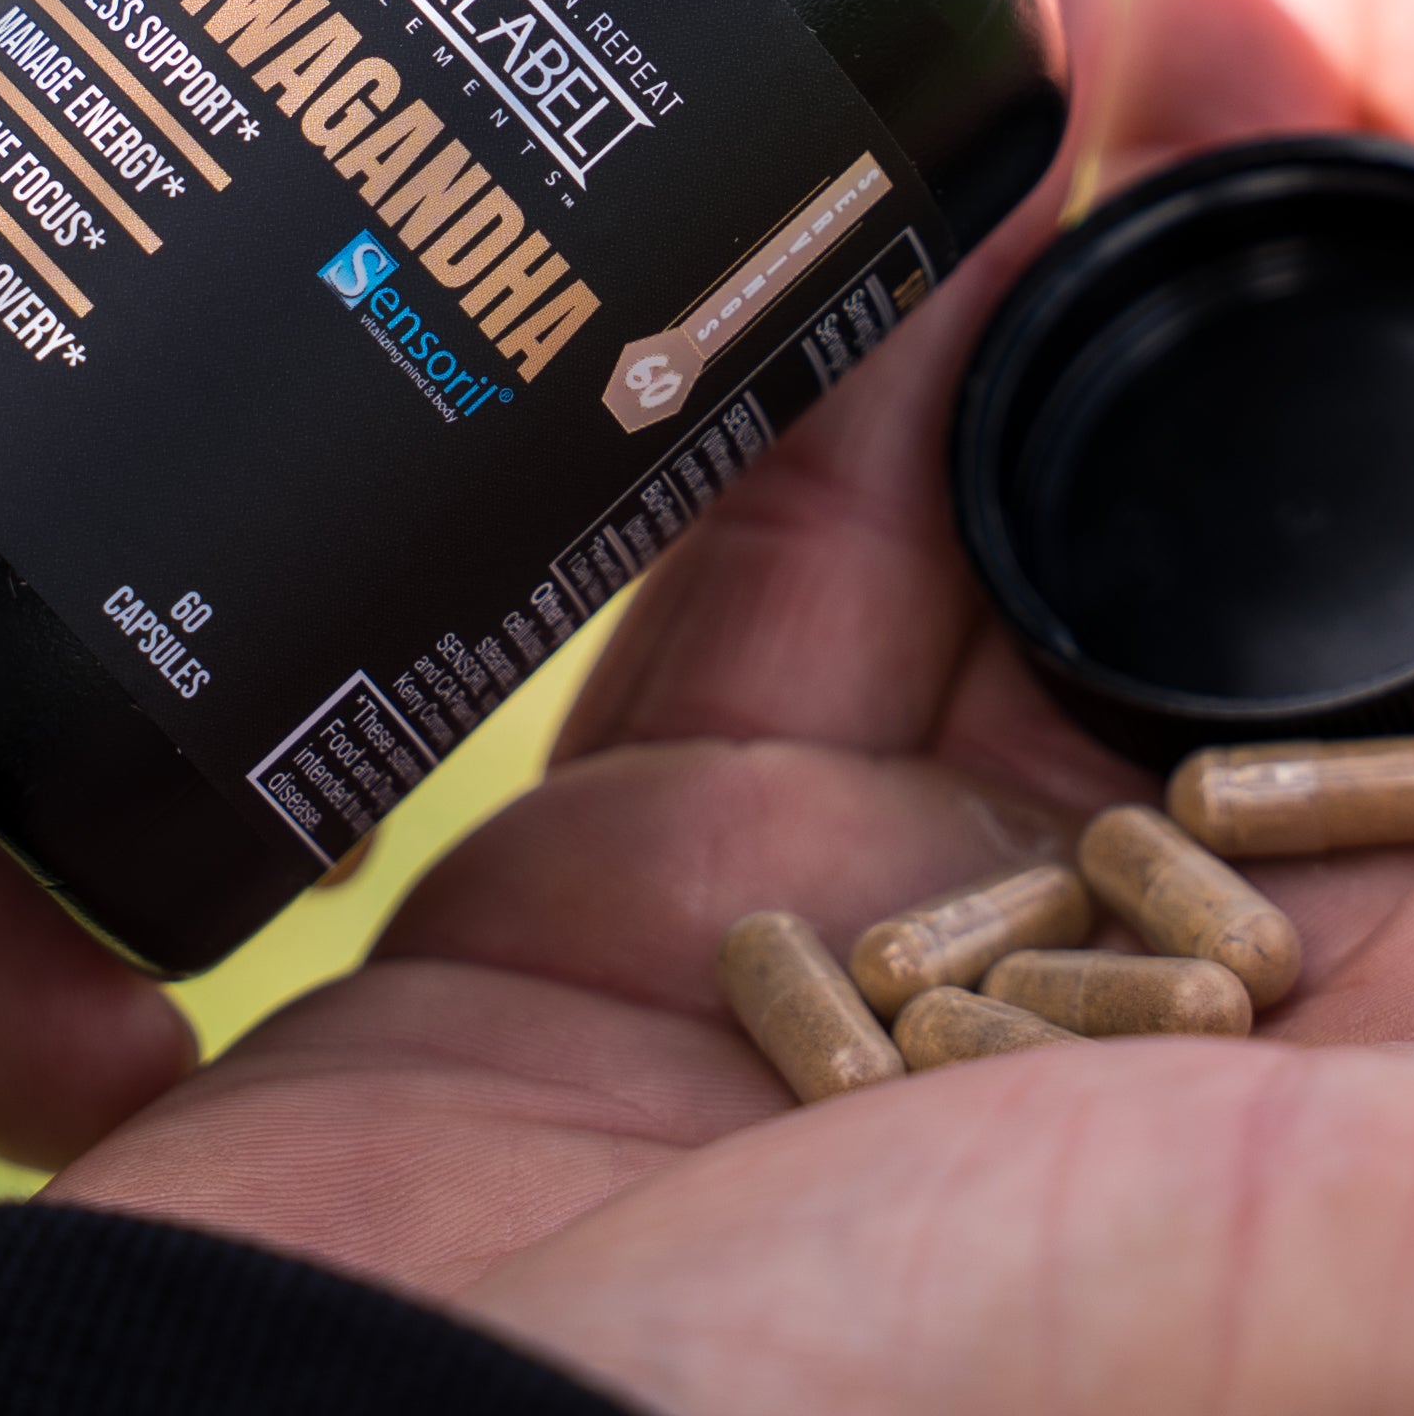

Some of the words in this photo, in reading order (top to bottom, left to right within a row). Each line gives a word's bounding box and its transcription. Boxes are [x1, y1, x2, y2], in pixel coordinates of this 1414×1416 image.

[585, 12, 684, 116] REPEAT
[697, 167, 880, 341] SERVINGS
[360, 313, 404, 364] vitalizing
[403, 361, 430, 390] mind
[423, 385, 436, 399] &
[431, 392, 459, 423] body
[625, 352, 683, 410] 60
[103, 585, 211, 699] CAPSULES
[171, 591, 212, 633] 60
[391, 670, 425, 714] Kerry
[412, 653, 444, 684] and
[292, 742, 353, 809] intended
[319, 717, 365, 767] Food
[351, 757, 381, 789] and
